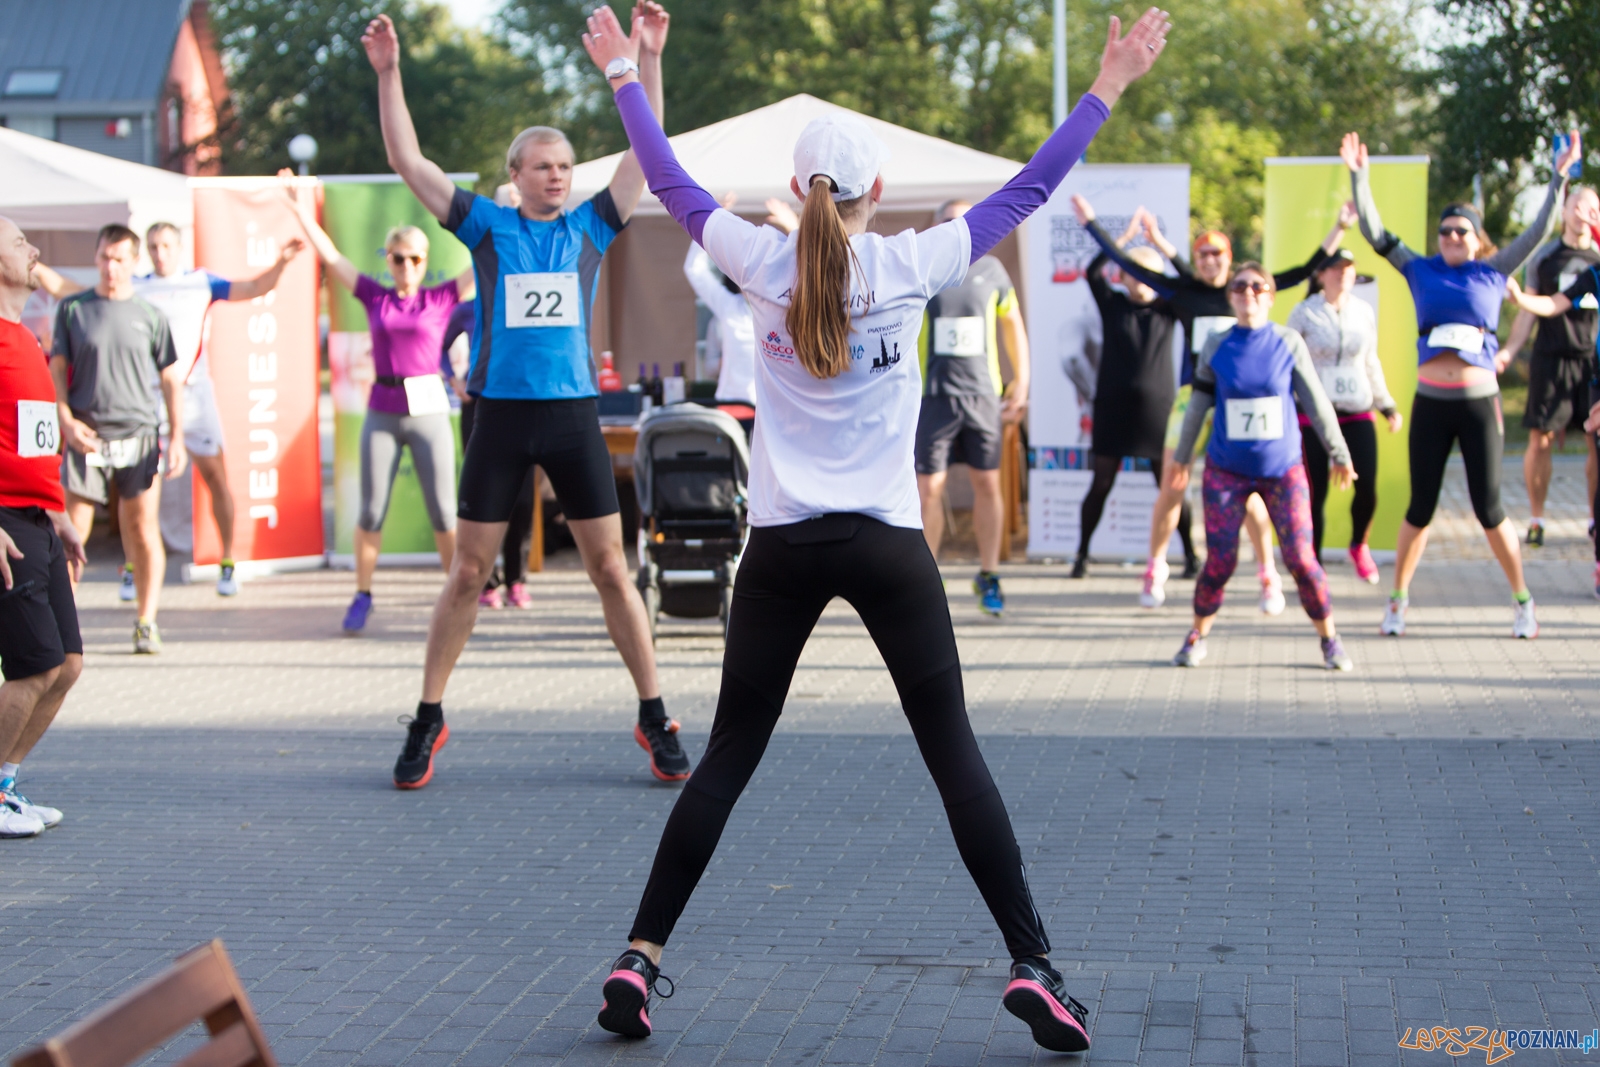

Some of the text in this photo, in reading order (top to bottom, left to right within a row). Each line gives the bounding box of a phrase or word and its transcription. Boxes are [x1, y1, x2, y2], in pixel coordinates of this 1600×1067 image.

[524, 290, 563, 318] 22
[760, 339, 794, 355] TESCO
[1335, 376, 1358, 394] 80
[1241, 412, 1268, 432] 71
[35, 420, 55, 449] 63
